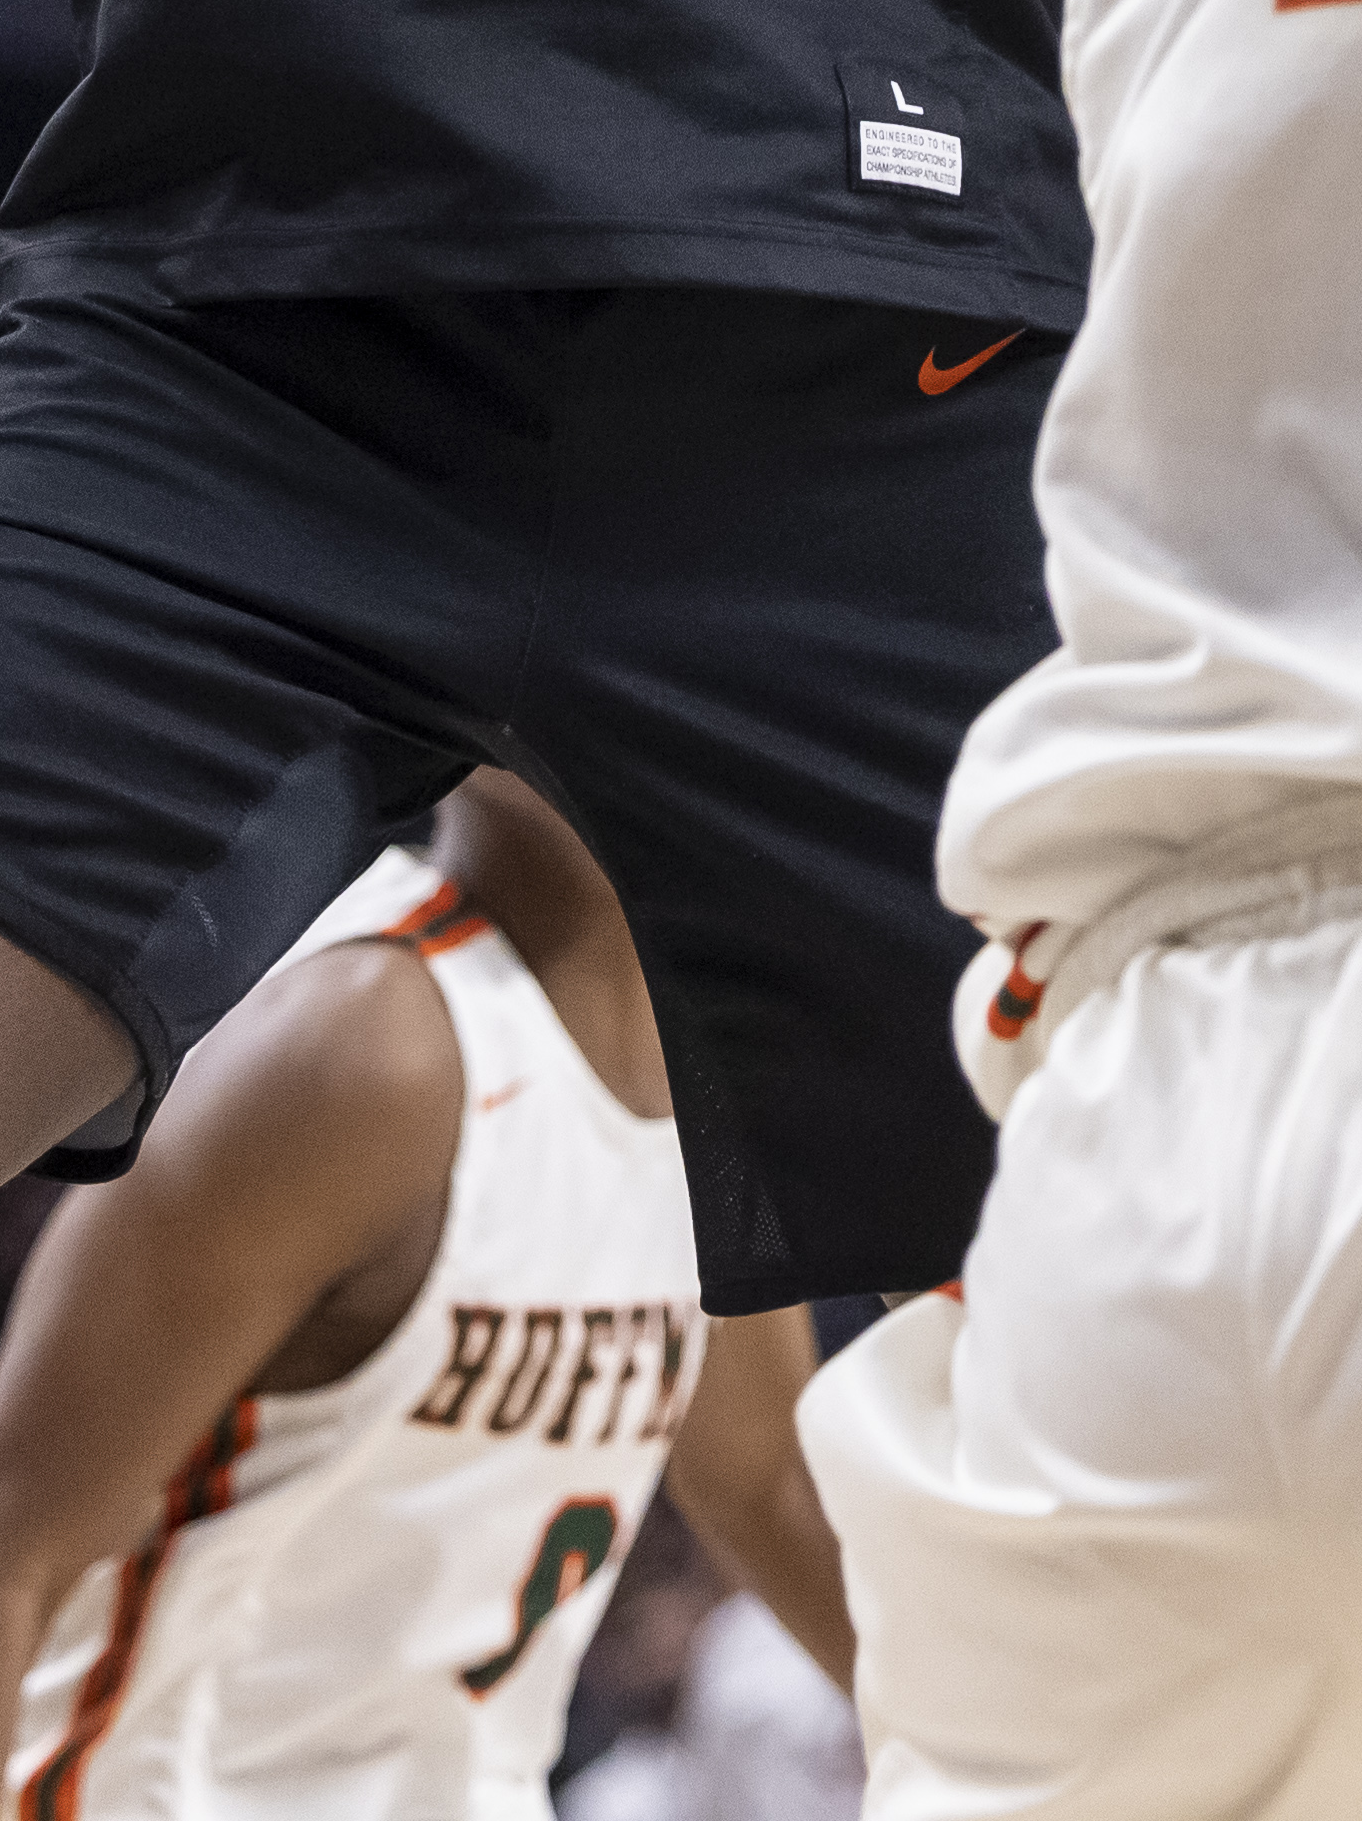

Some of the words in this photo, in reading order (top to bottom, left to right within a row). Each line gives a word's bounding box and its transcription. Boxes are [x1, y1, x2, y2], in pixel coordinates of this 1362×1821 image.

[890, 80, 925, 116] L
[865, 128, 925, 147] ENGINEERED
[928, 137, 939, 150] TO
[942, 140, 957, 154] THE
[866, 144, 891, 157] EXACT
[892, 147, 947, 168] SPECIFICATIONS
[948, 158, 957, 169] OF
[866, 160, 924, 178] CHAMPIONSHIP
